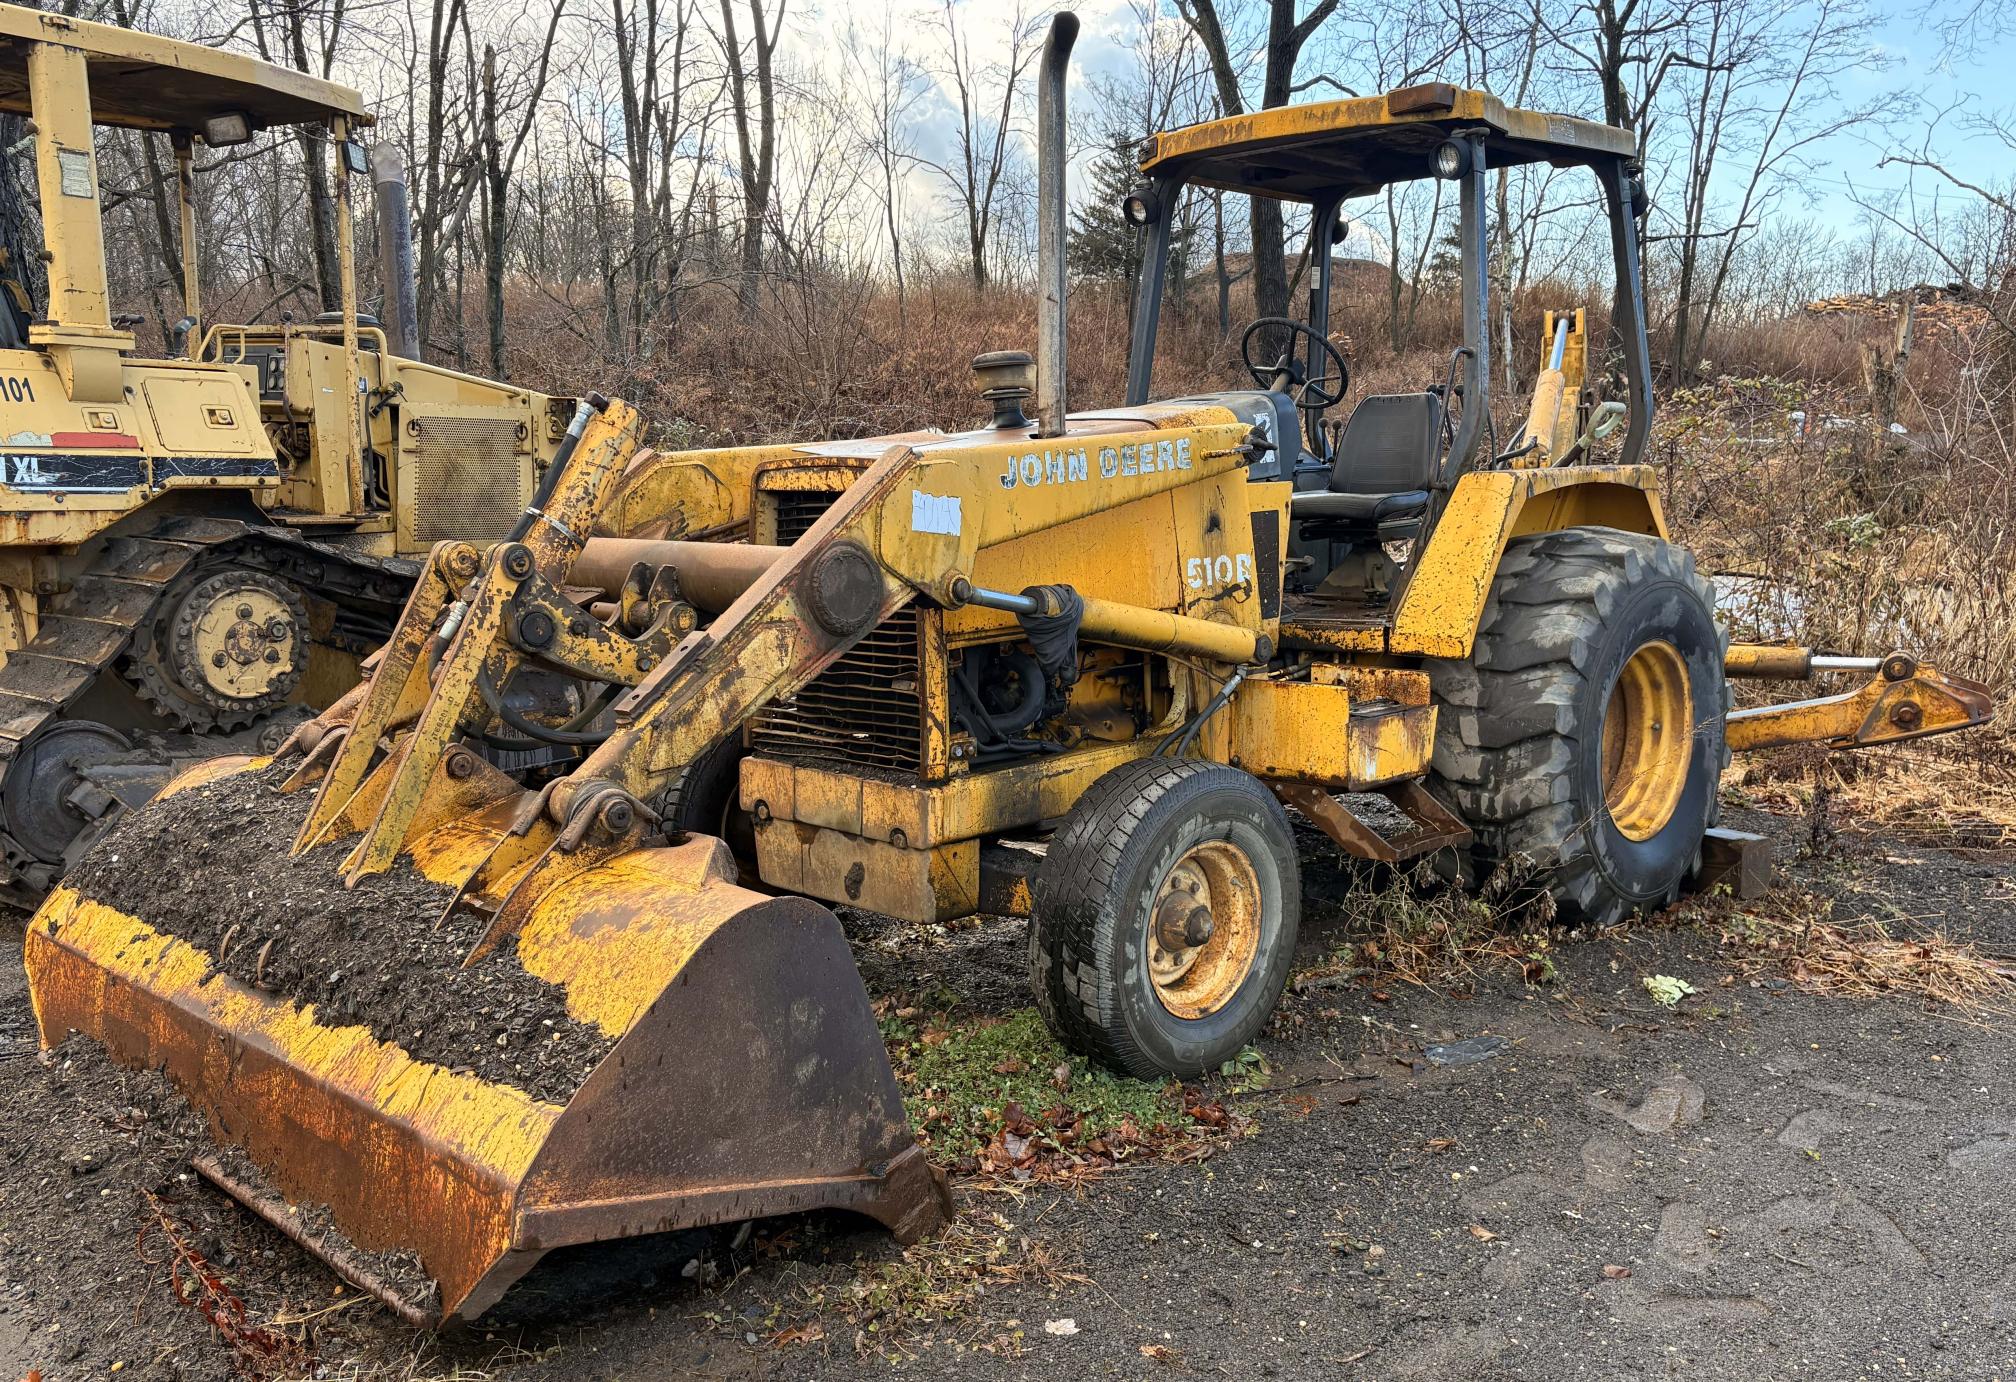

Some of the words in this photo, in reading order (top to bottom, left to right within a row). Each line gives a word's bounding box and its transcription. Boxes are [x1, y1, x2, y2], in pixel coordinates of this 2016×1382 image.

[13, 457, 46, 482] XL
[1000, 448, 1088, 489] JOHN
[1099, 438, 1192, 478] DEERE
